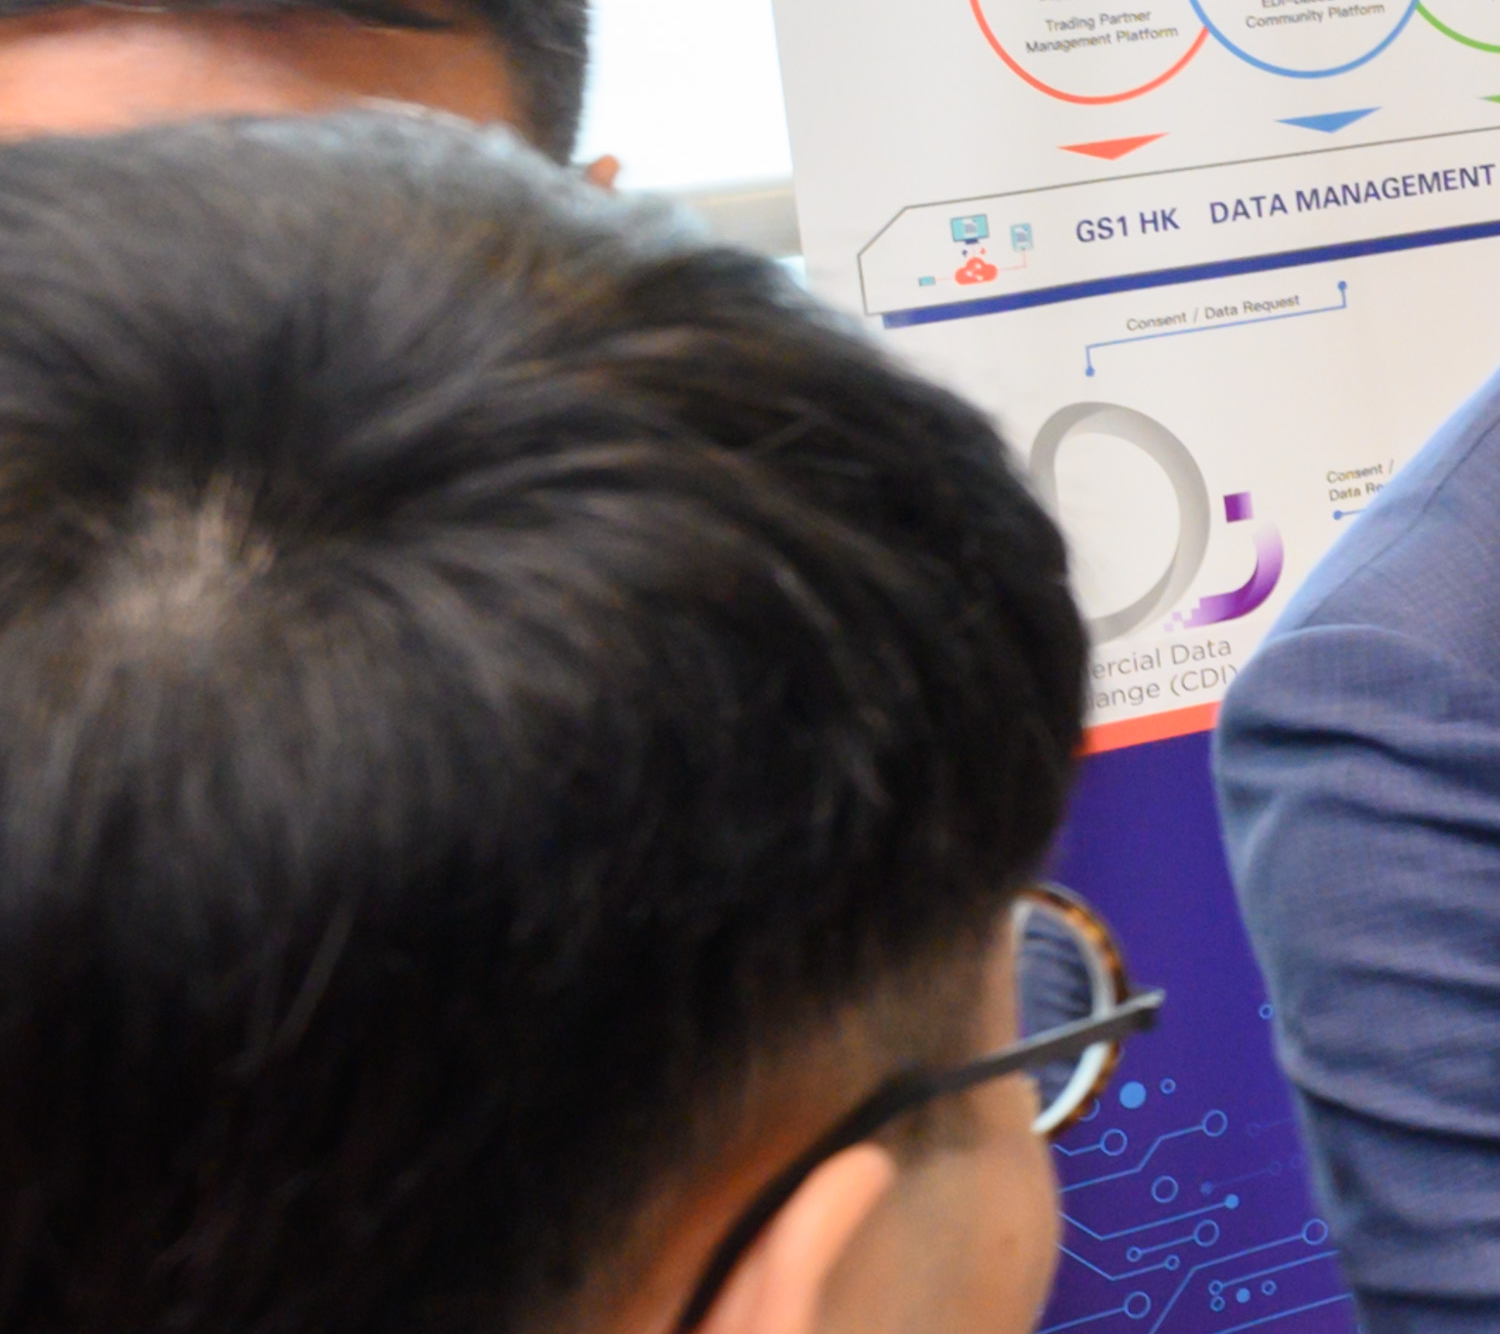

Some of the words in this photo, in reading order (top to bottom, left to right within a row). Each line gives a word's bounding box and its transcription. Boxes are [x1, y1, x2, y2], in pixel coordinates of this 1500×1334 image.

[1045, 16, 1095, 33] Trading
[1099, 11, 1152, 26] Partner
[1245, 10, 1323, 29] Community
[1328, 4, 1385, 19] Platform
[1025, 33, 1112, 54] Management
[1115, 26, 1179, 43] Platform
[1076, 214, 1129, 244] GS1
[1139, 207, 1181, 236] HK
[1209, 193, 1289, 225] DATA
[1294, 163, 1496, 214] MANAGEMENT
[1126, 312, 1188, 332] Consent
[1204, 305, 1239, 320] Data
[1242, 295, 1300, 314] Request
[1326, 463, 1383, 484] Consent
[1328, 487, 1361, 502] Data
[1089, 647, 1162, 681] ercial
[1171, 639, 1232, 666] Data
[1090, 681, 1161, 710] ange
